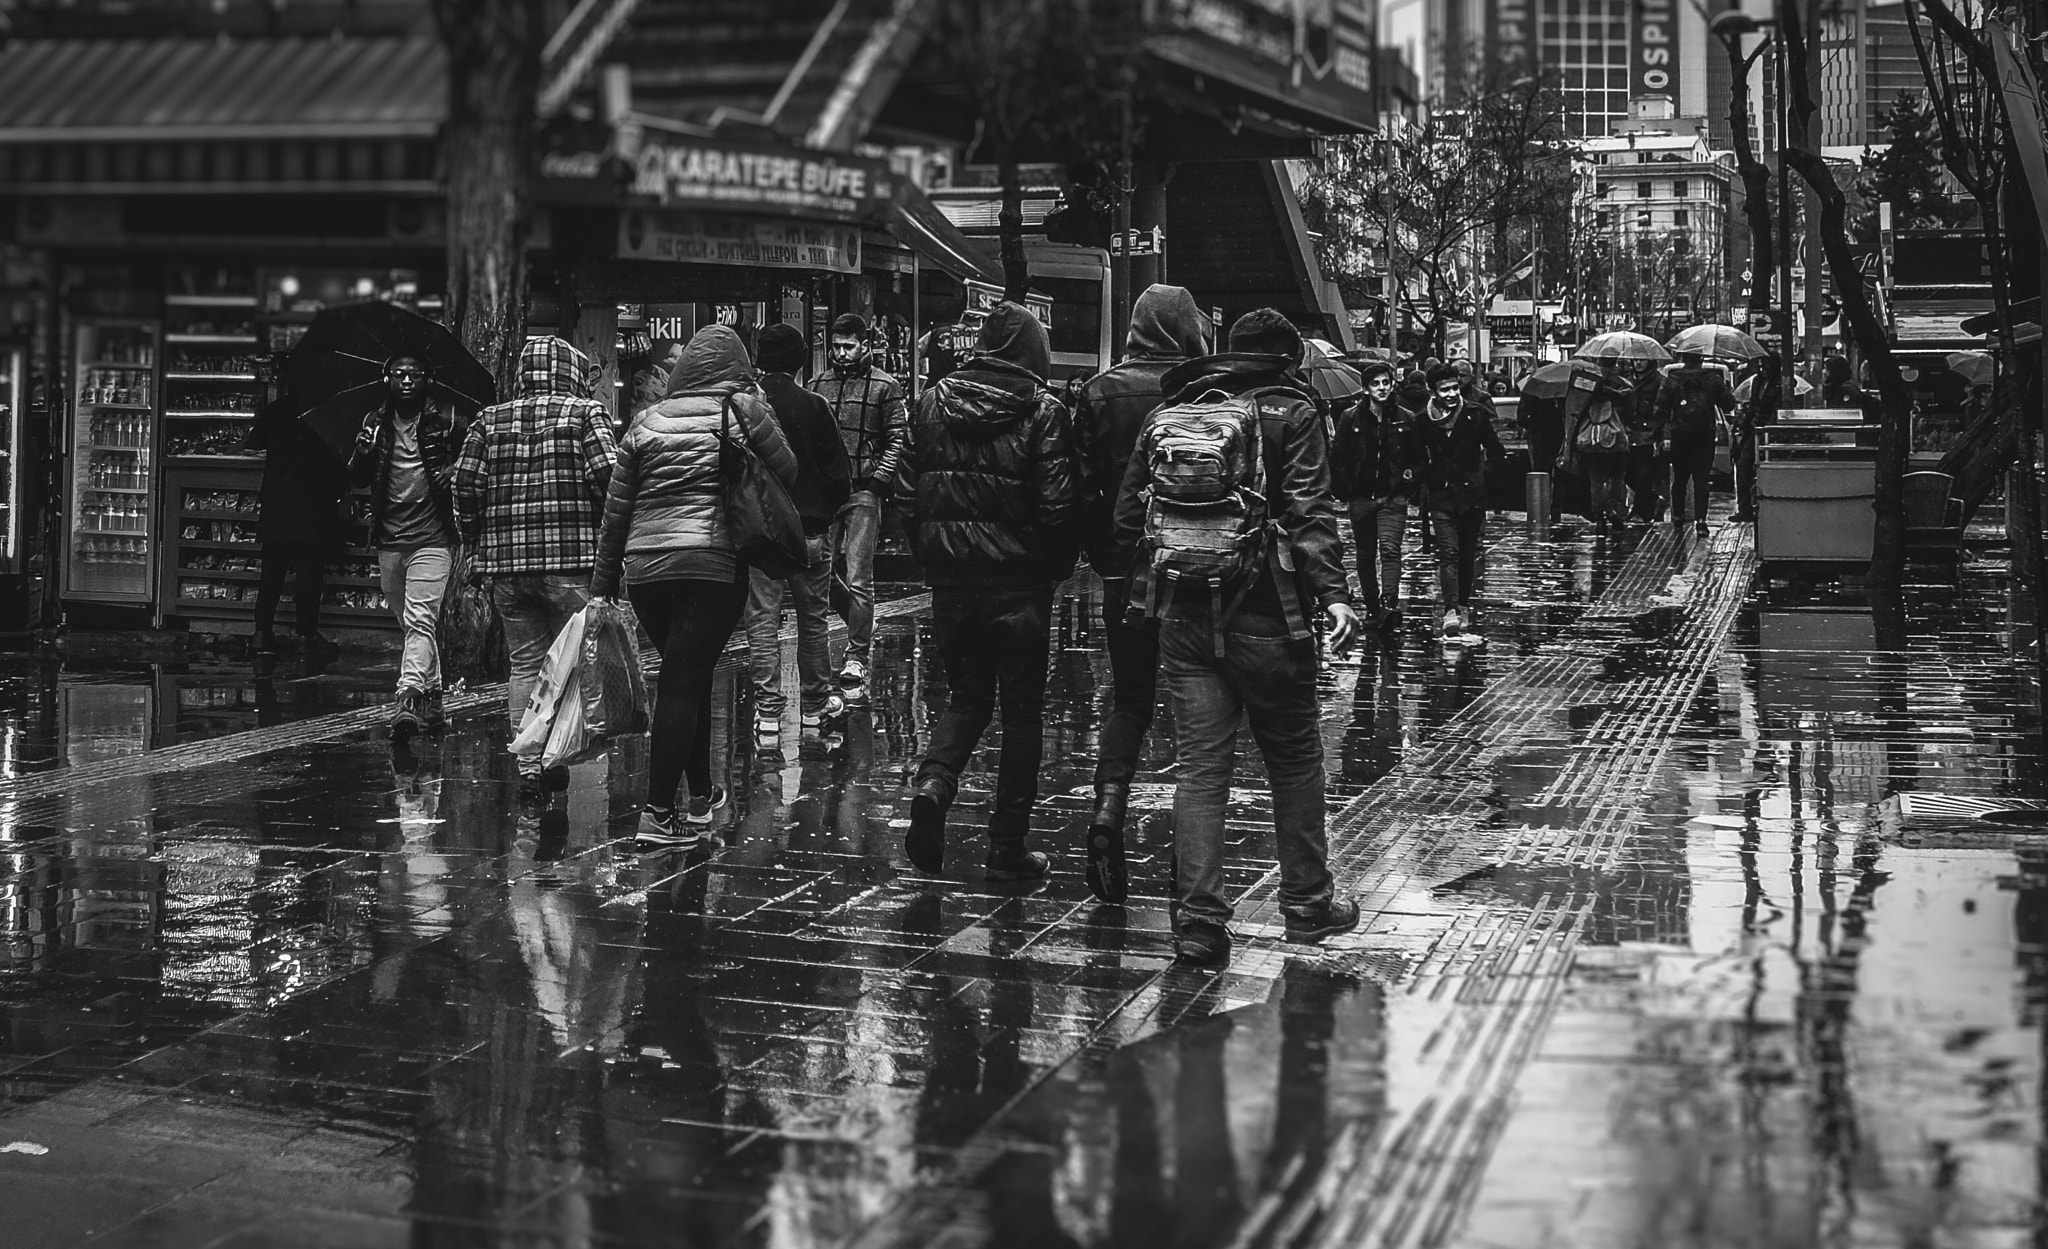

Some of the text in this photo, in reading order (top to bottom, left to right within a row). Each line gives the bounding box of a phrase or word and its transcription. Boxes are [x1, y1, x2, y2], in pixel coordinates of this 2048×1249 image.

[1641, 0, 1669, 95] OSPI
[666, 147, 801, 190] KARATEPE
[802, 158, 866, 198] BÜFE
[761, 244, 799, 263] TELEFON
[646, 317, 682, 340] ikli
